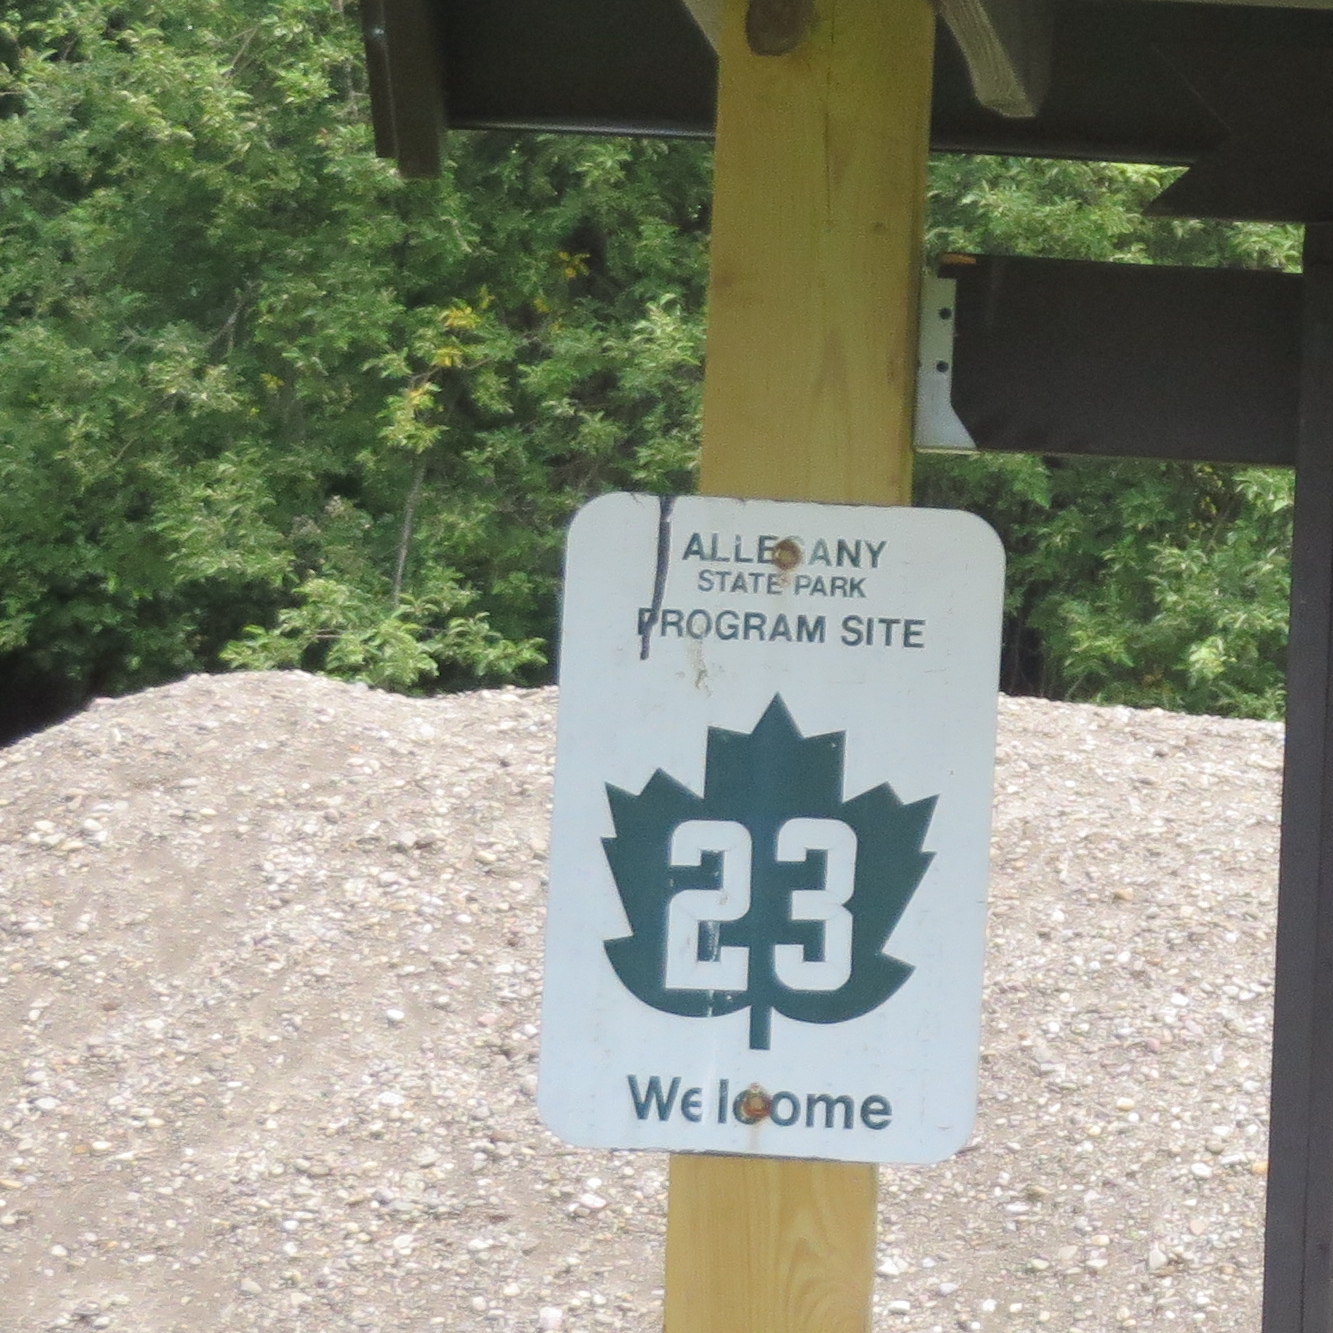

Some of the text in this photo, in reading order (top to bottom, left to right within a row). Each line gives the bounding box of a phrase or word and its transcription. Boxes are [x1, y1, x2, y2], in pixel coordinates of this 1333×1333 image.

[682, 532, 888, 568] ALLEANY
[697, 569, 867, 598] STATE PARK
[638, 607, 926, 648] PROGRAM SITE
[664, 817, 857, 991] 23
